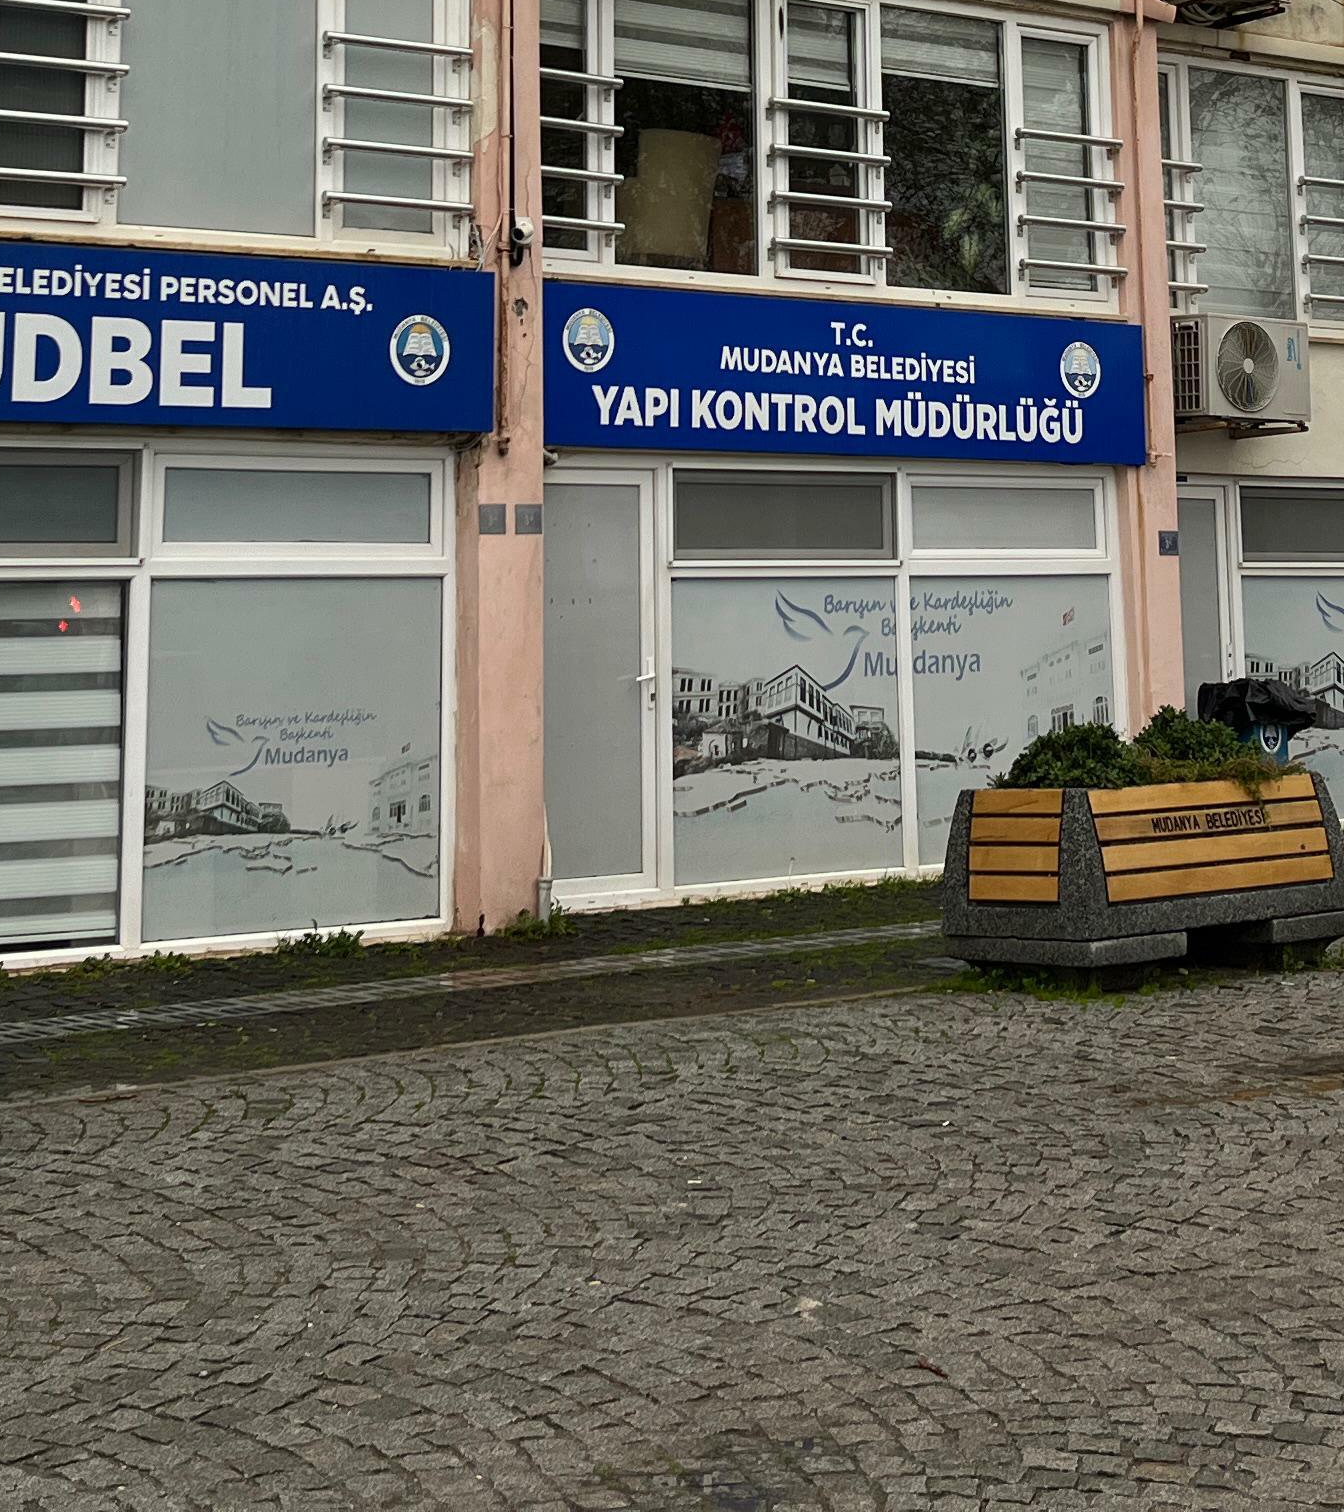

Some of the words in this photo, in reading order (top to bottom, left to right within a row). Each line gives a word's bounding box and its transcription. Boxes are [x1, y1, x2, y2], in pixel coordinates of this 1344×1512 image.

[160, 276, 313, 308] PERSONEL
[320, 285, 373, 315] A.Ş.
[830, 321, 873, 348] T.C.
[720, 345, 843, 377] MUDANYA
[851, 351, 975, 384] BELEDİYESİ
[592, 384, 679, 427] YAPI
[692, 391, 865, 435] KONTROL
[876, 393, 1083, 443] MÜDÜRLÜĞÜ
[823, 594, 886, 620] Barışın
[924, 590, 1013, 616] Kardeşliğin
[864, 649, 981, 680] Mudanya
[265, 746, 349, 768] Mudanya
[1151, 814, 1201, 834] MUDANYA
